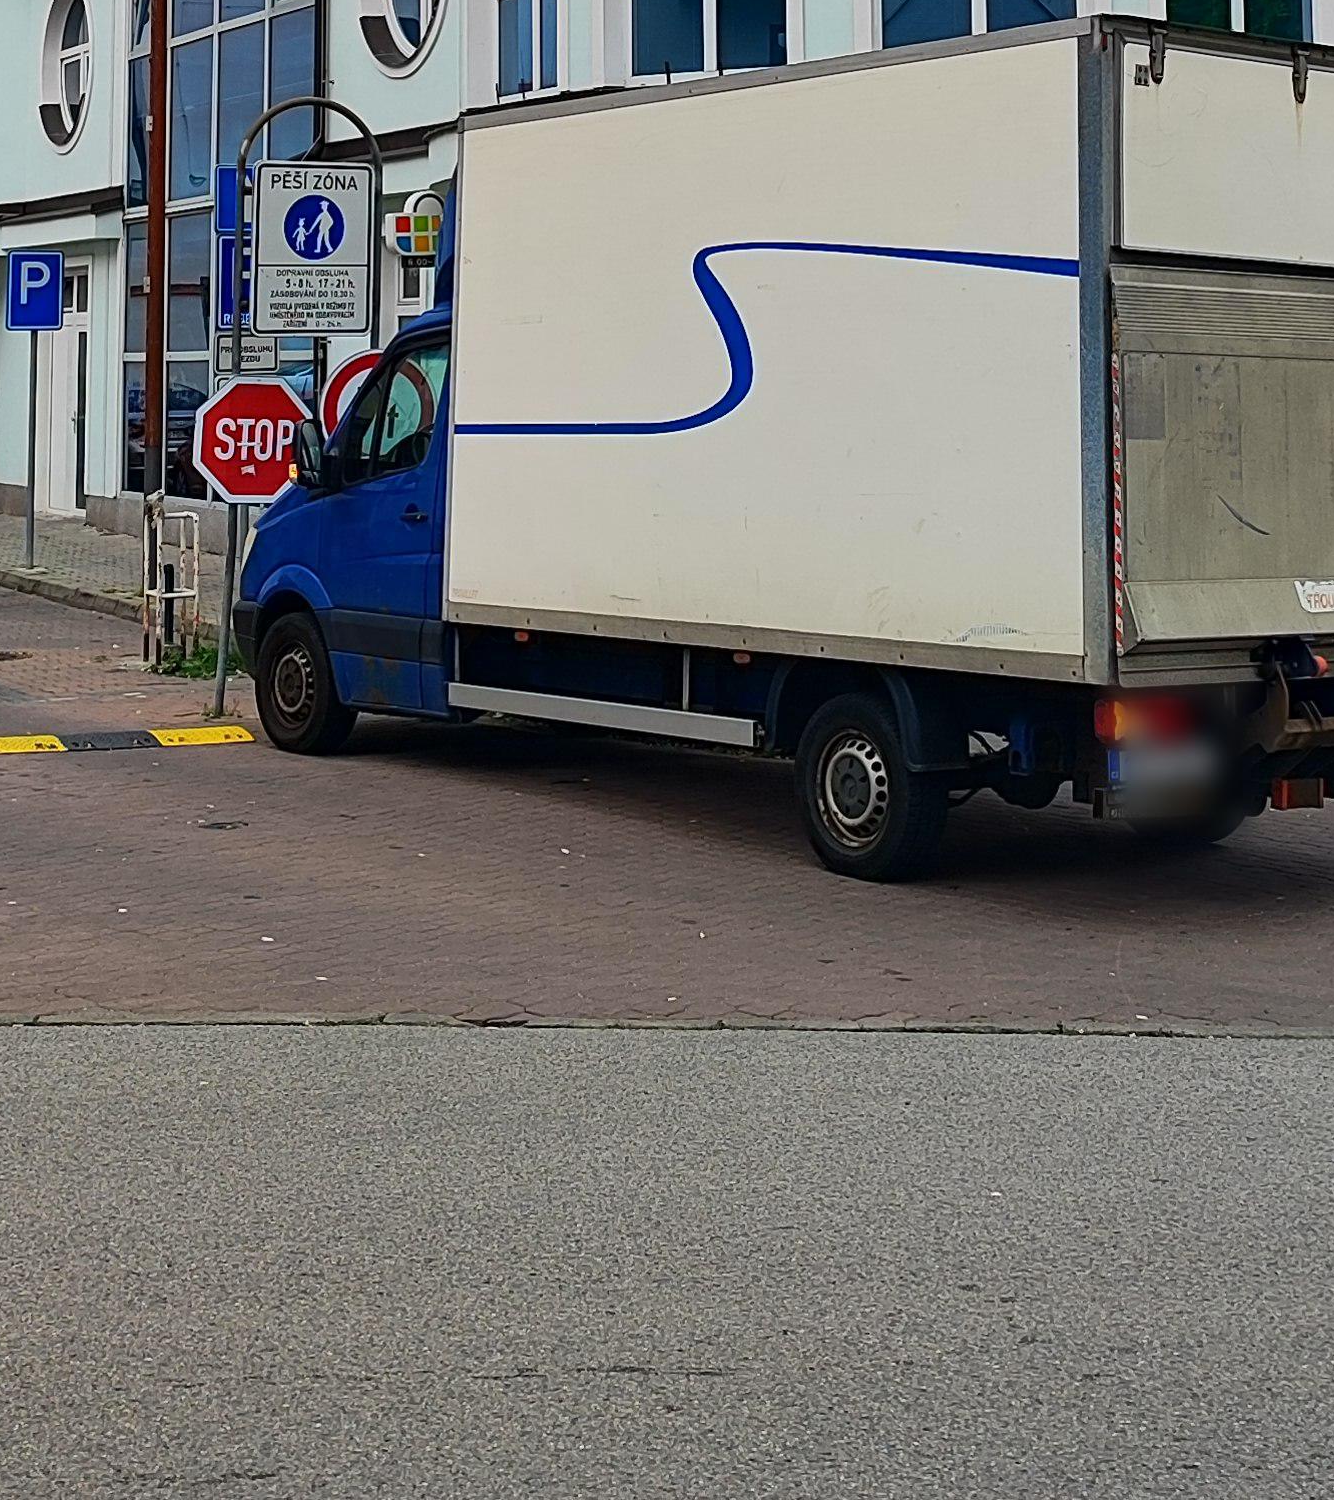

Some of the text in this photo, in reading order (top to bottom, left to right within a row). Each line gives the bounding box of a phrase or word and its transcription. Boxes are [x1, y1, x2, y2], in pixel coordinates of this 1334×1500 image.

[271, 171, 358, 190] PĚŠÍ ZÓNA
[276, 268, 349, 277] DOPRAVNÍ OBSLUHA
[20, 261, 51, 305] P
[319, 279, 329, 288] 17
[270, 289, 317, 298] ZÁSOBOVÁNÍ
[214, 417, 295, 462] STOP
